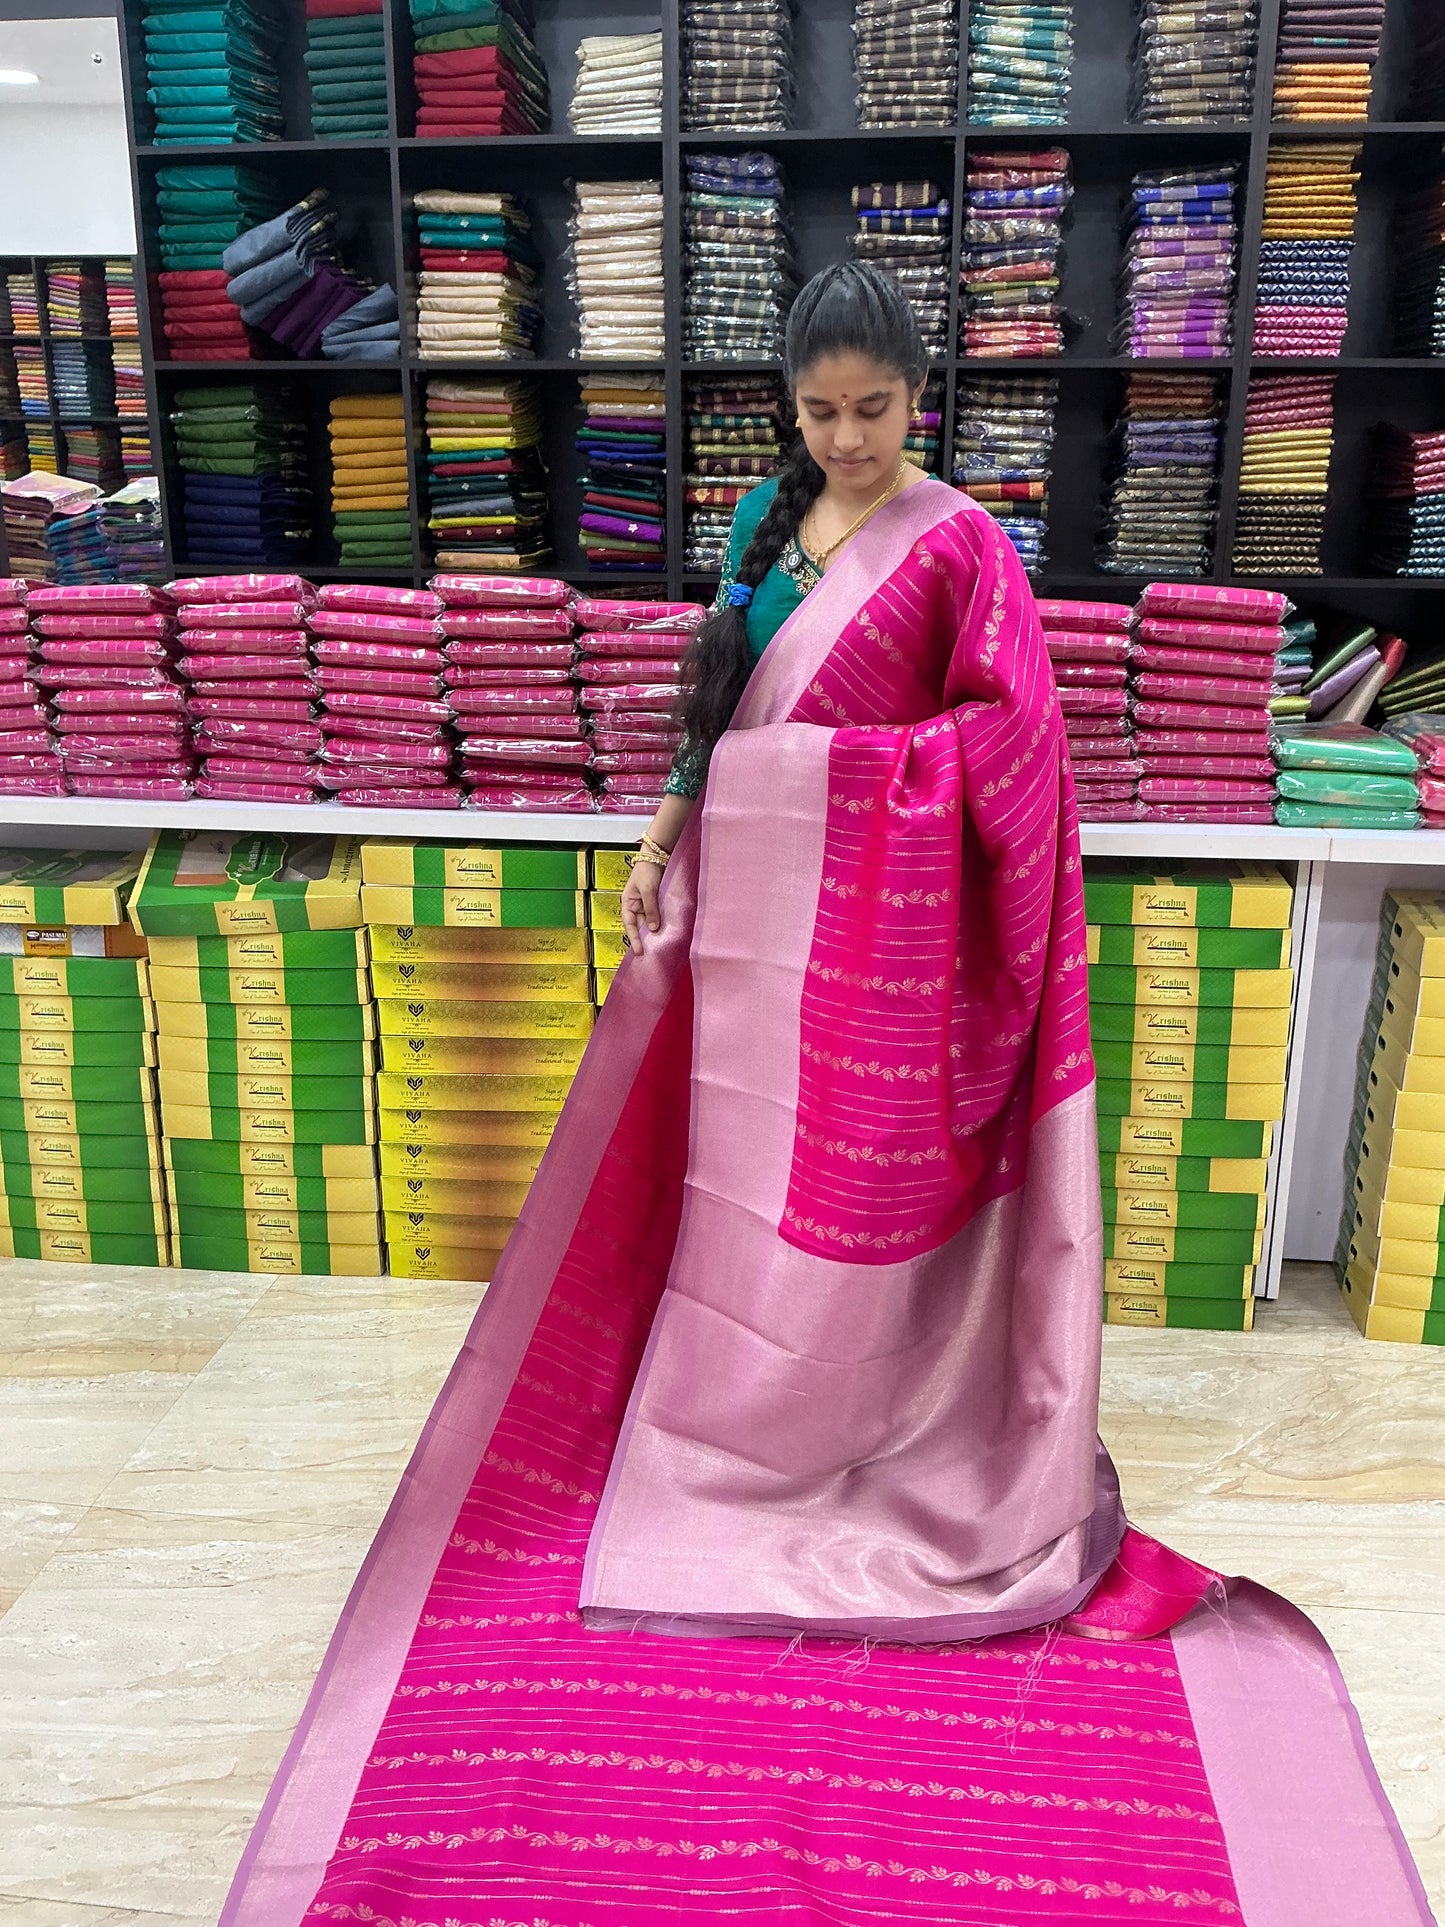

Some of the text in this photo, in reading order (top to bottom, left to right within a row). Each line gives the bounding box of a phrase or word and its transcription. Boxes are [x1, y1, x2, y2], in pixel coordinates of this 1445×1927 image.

[340, 841, 358, 877] Amazing
[456, 858, 493, 870] Krishna
[0, 898, 26, 907] rishna
[455, 897, 492, 909] Krishna
[1145, 895, 1186, 907] Krishna
[228, 909, 266, 919] Krishna
[239, 939, 274, 951] Krishna
[1147, 935, 1187, 948] Krishna
[24, 967, 58, 978] Krishna
[241, 976, 276, 987] Krishna
[1149, 974, 1189, 987] Krishna
[30, 1003, 64, 1013] Krishna
[248, 1011, 283, 1022] Krishna
[1147, 1013, 1187, 1025] Krishna
[31, 1037, 65, 1048] Krishna
[248, 1046, 283, 1057] Krishna
[1144, 1050, 1184, 1062] Krishna
[30, 1072, 63, 1083] Krishna
[249, 1081, 283, 1092] Krishna
[1143, 1088, 1183, 1100] Krishna
[34, 1106, 68, 1117] Krishna
[251, 1115, 286, 1126] Krishna
[1133, 1125, 1172, 1137] Krishna
[39, 1139, 72, 1149] Krishna
[251, 1148, 285, 1159] Krishna
[1128, 1160, 1167, 1172] Krishna
[42, 1171, 74, 1182] Krishna
[255, 1182, 289, 1193] Krishna
[1129, 1196, 1168, 1208] Krishna
[46, 1204, 78, 1214] Krishna
[257, 1214, 290, 1225] Krishna
[50, 1235, 83, 1246] Krishna
[1127, 1231, 1165, 1243] Krishna
[259, 1247, 293, 1257] Krishna
[1117, 1265, 1155, 1277] Krishna
[1119, 1297, 1157, 1309] Krishna
